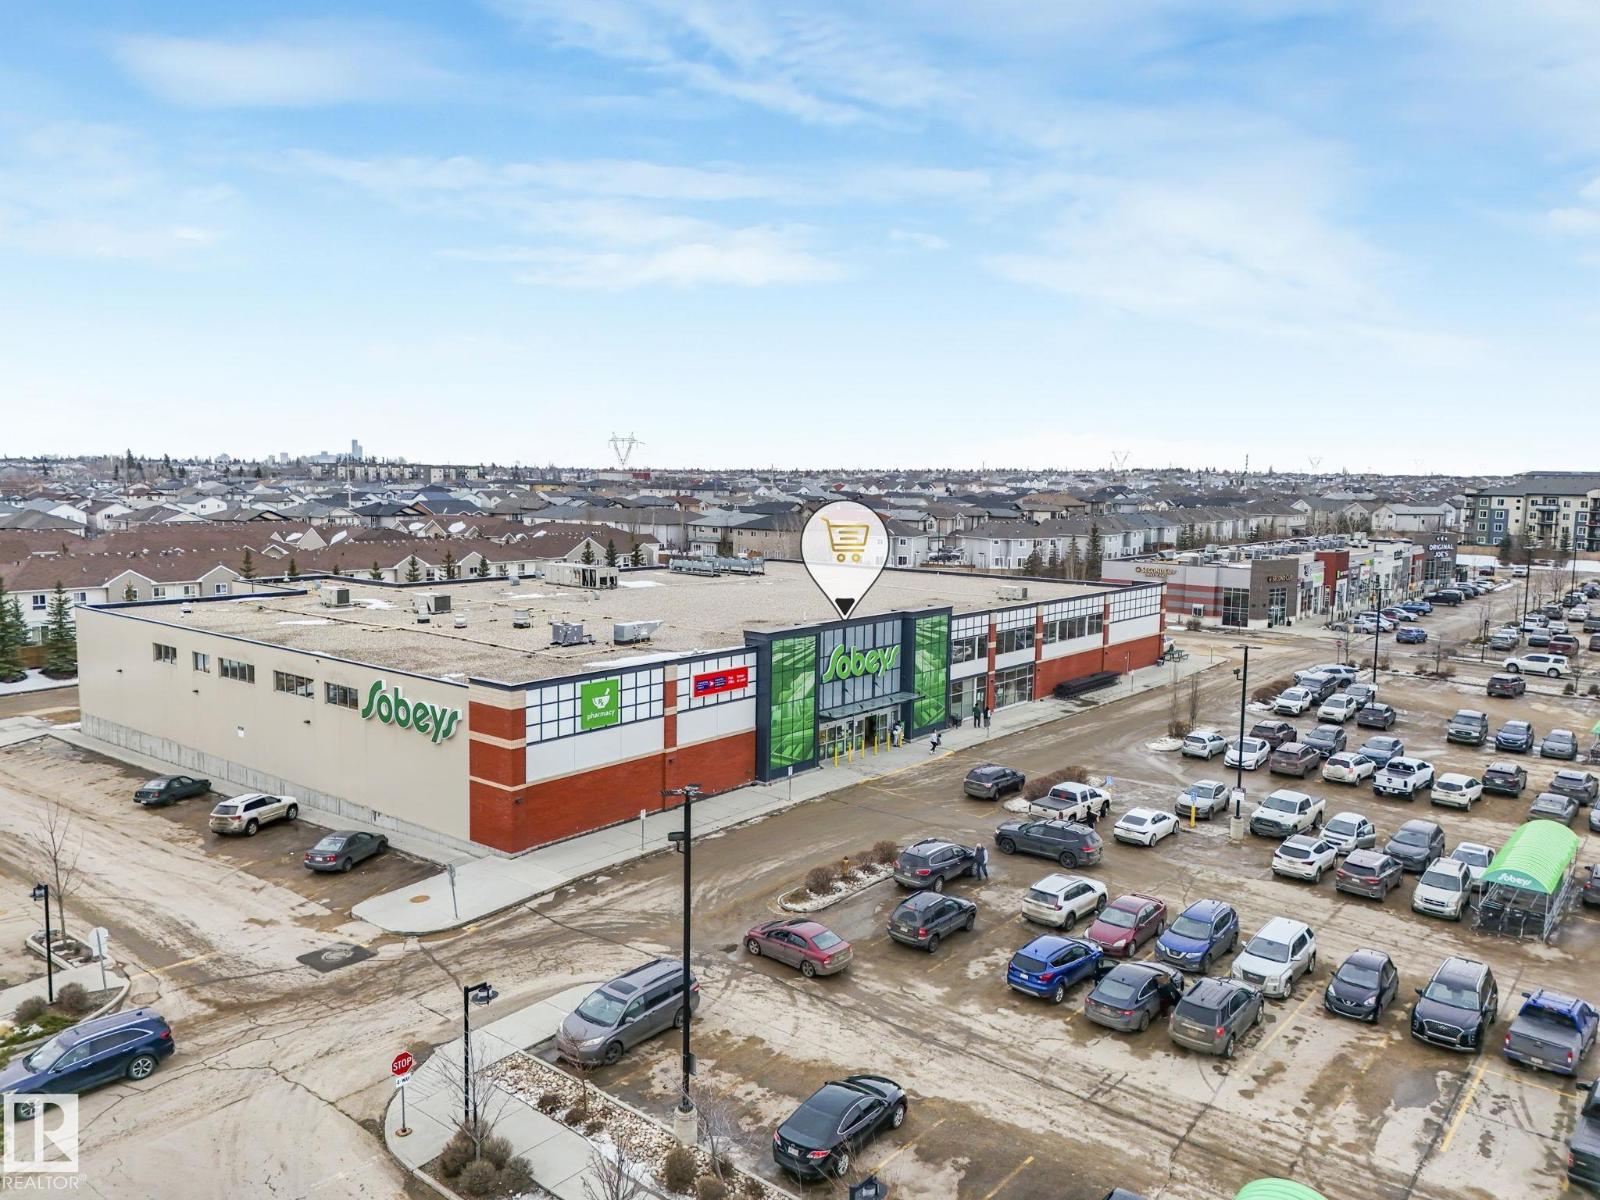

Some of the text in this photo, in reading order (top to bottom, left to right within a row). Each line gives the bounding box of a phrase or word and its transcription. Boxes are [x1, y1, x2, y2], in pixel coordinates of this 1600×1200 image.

[822, 643, 900, 684] Sobeys
[361, 680, 462, 744] Sobeys
[587, 710, 616, 722] pharmacy
[1498, 872, 1532, 887] Sobeys
[393, 1056, 412, 1072] STOP
